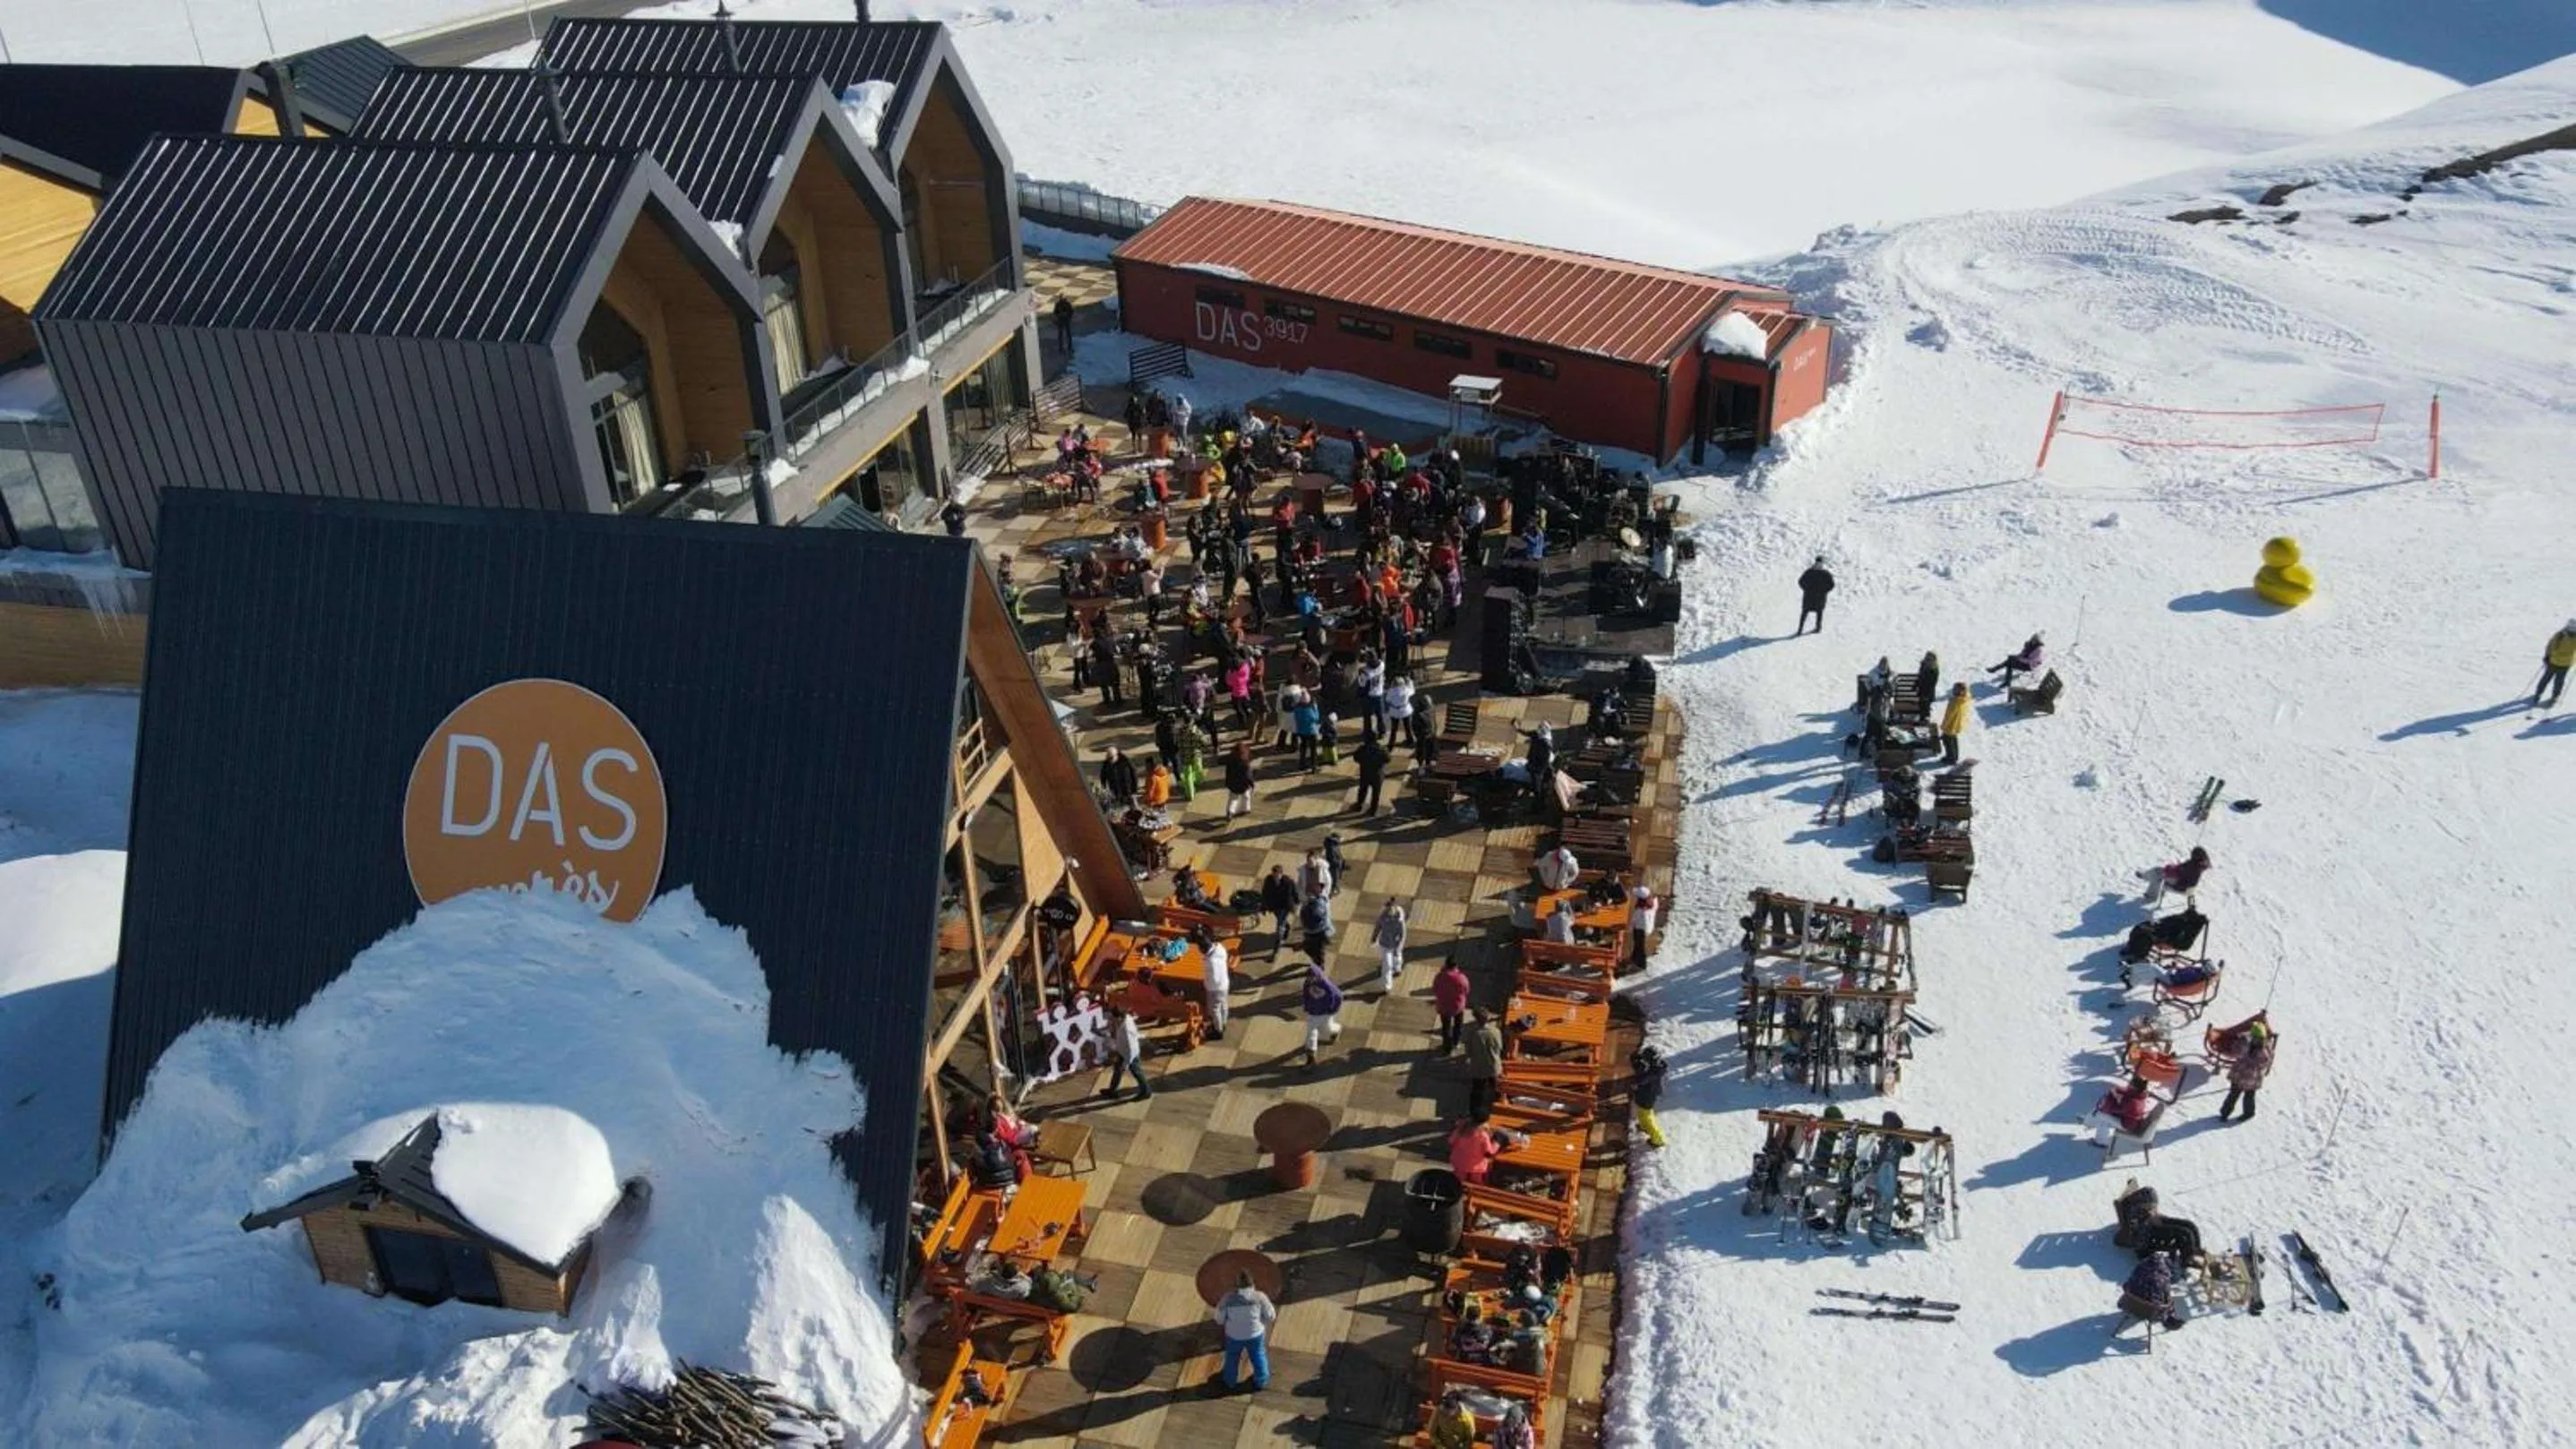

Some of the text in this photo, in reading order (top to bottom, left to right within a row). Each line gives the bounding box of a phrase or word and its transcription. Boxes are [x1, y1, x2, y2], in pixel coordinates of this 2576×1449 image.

[1196, 301, 1308, 351] DAS 3917
[442, 733, 639, 851] DAS
